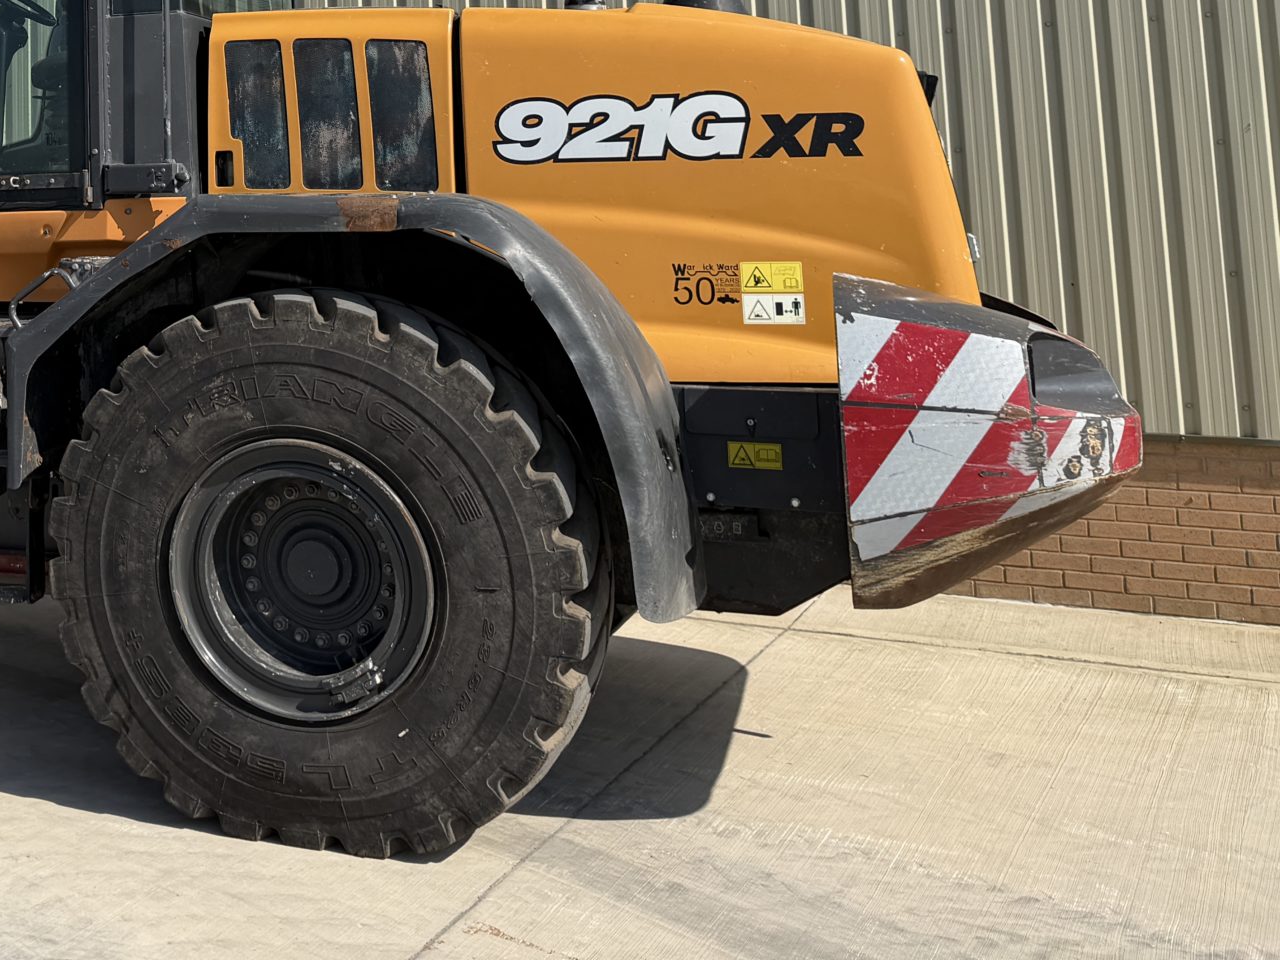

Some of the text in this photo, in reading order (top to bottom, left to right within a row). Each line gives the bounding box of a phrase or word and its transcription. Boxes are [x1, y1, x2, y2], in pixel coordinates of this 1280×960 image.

[492, 90, 866, 164] 921G XR
[673, 276, 716, 305] 50
[716, 263, 739, 271] Ward
[153, 373, 485, 523] TRIANGLE
